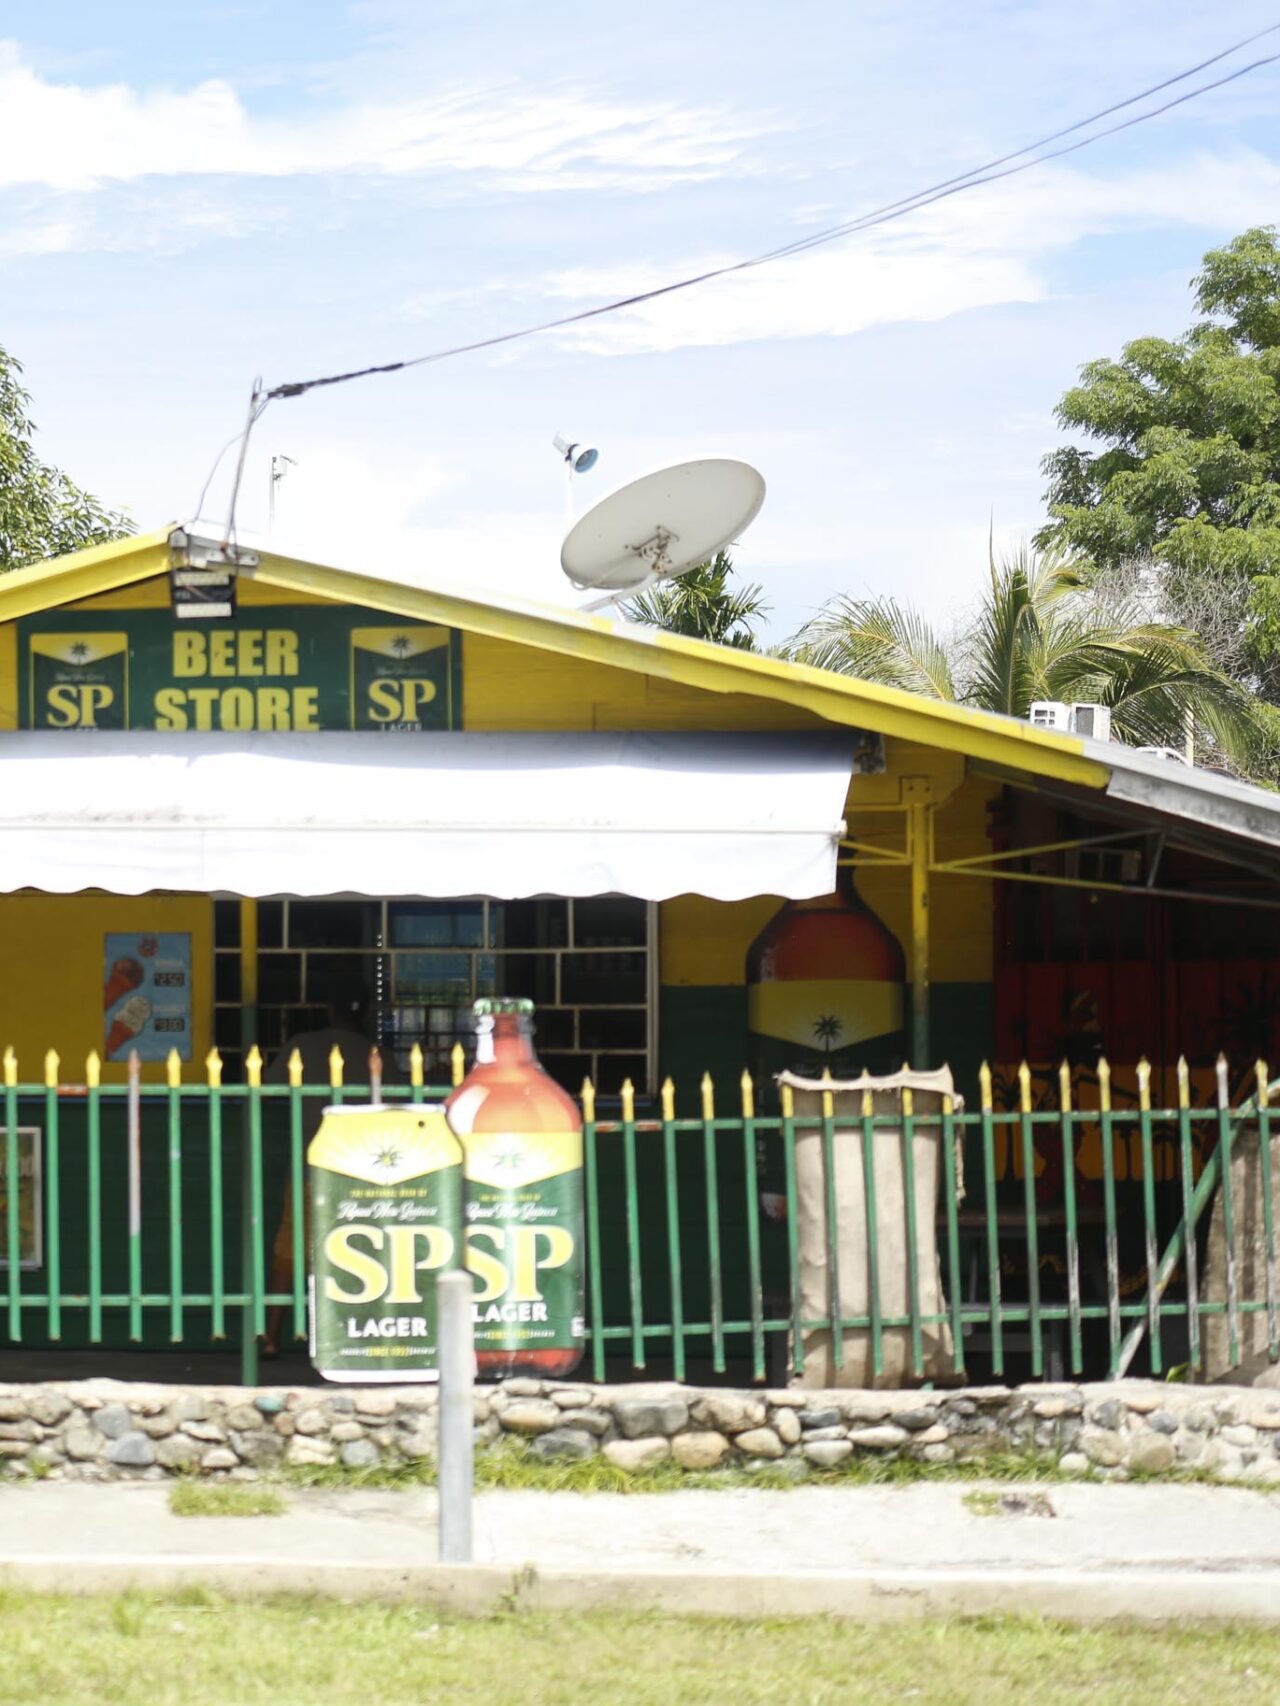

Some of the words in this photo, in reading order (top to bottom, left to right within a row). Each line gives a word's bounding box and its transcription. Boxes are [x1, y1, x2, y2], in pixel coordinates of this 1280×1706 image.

[173, 629, 298, 677] BEER
[47, 684, 114, 727] SP
[154, 687, 319, 731] STORE
[368, 678, 436, 723] SP
[324, 1224, 453, 1304] SP
[465, 1224, 574, 1302] SP
[347, 1317, 428, 1338] LAGER
[470, 1302, 548, 1322] LAGER
